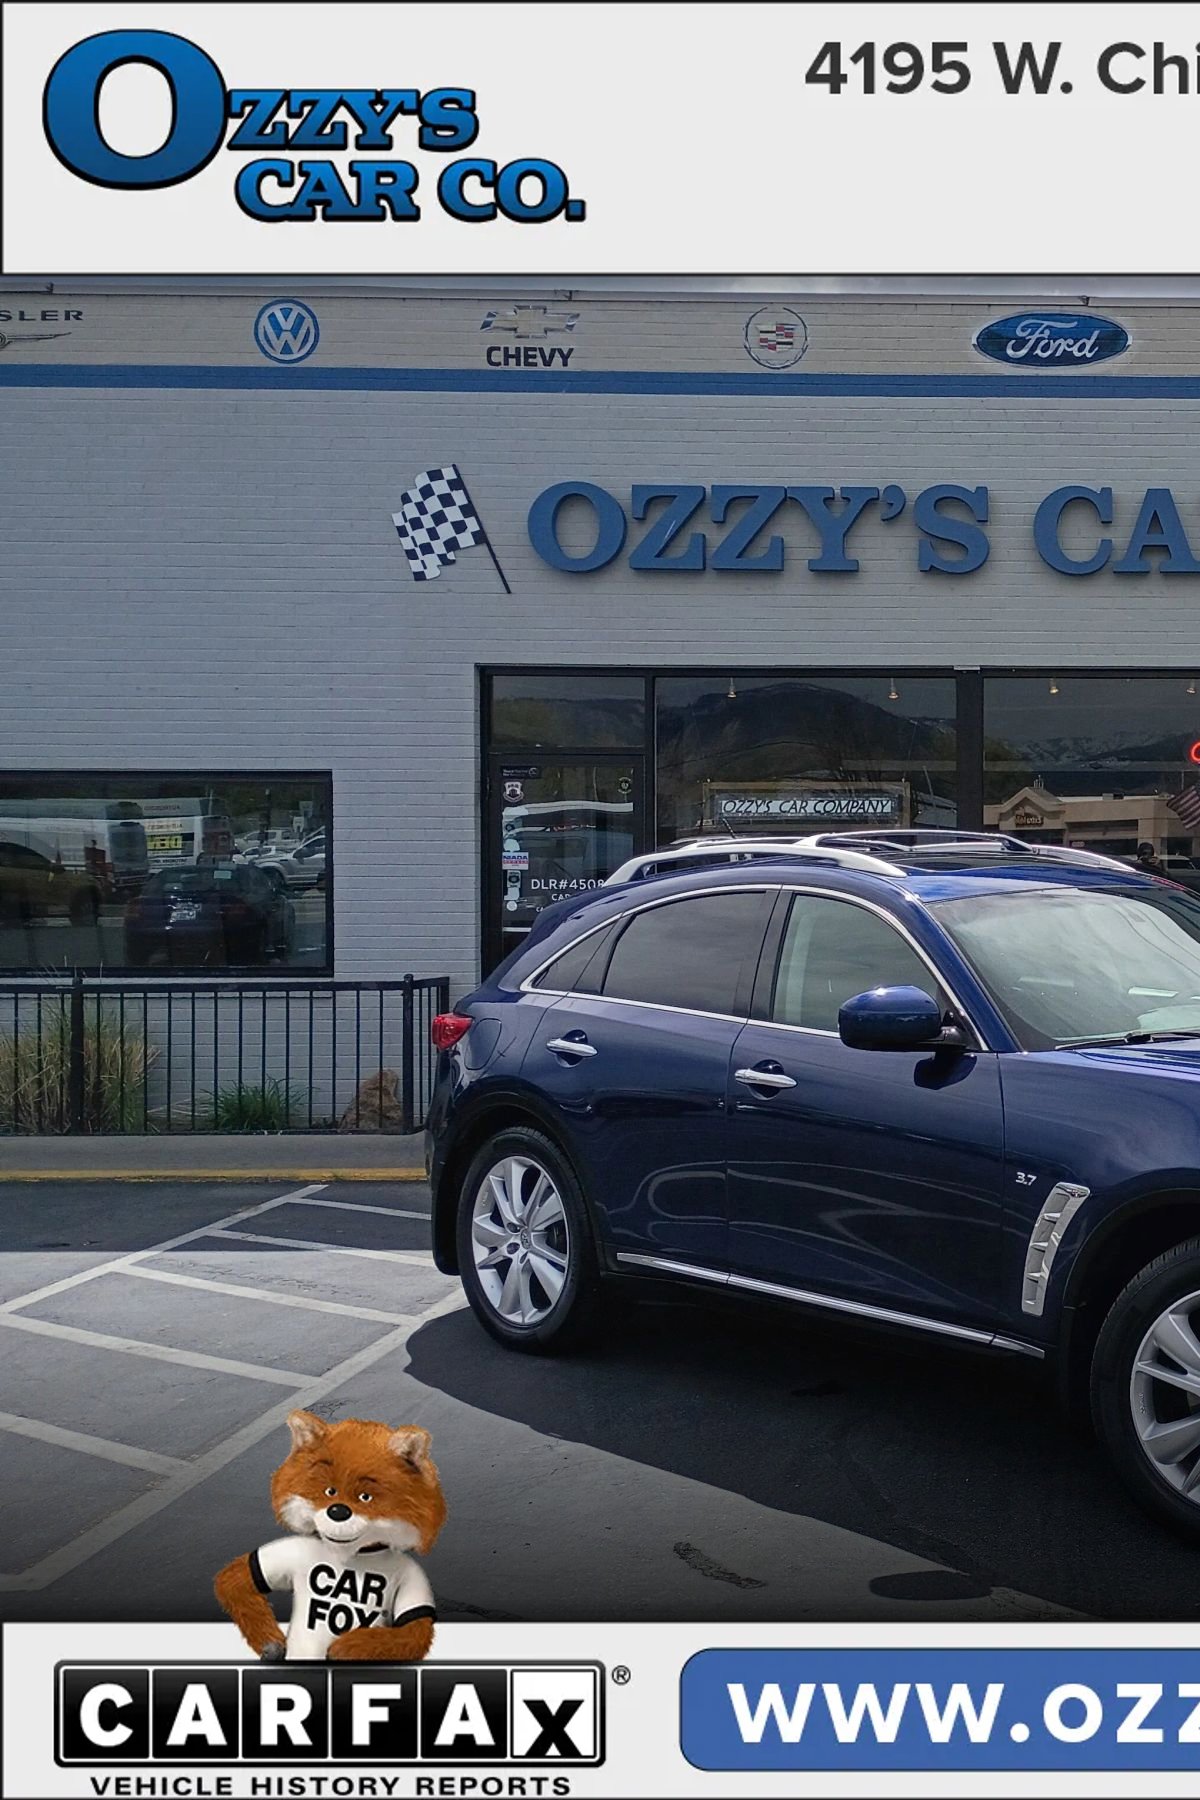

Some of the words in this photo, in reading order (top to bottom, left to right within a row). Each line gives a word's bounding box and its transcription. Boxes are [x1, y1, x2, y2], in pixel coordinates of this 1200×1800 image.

[1006, 319, 1100, 359] Ford
[486, 346, 574, 368] CHEVY
[527, 480, 990, 575] OZZY'S
[723, 799, 772, 813] OZZY'S
[779, 799, 808, 813] CAR
[813, 799, 890, 813] COMPANY
[1015, 1172, 1037, 1186] 3.7
